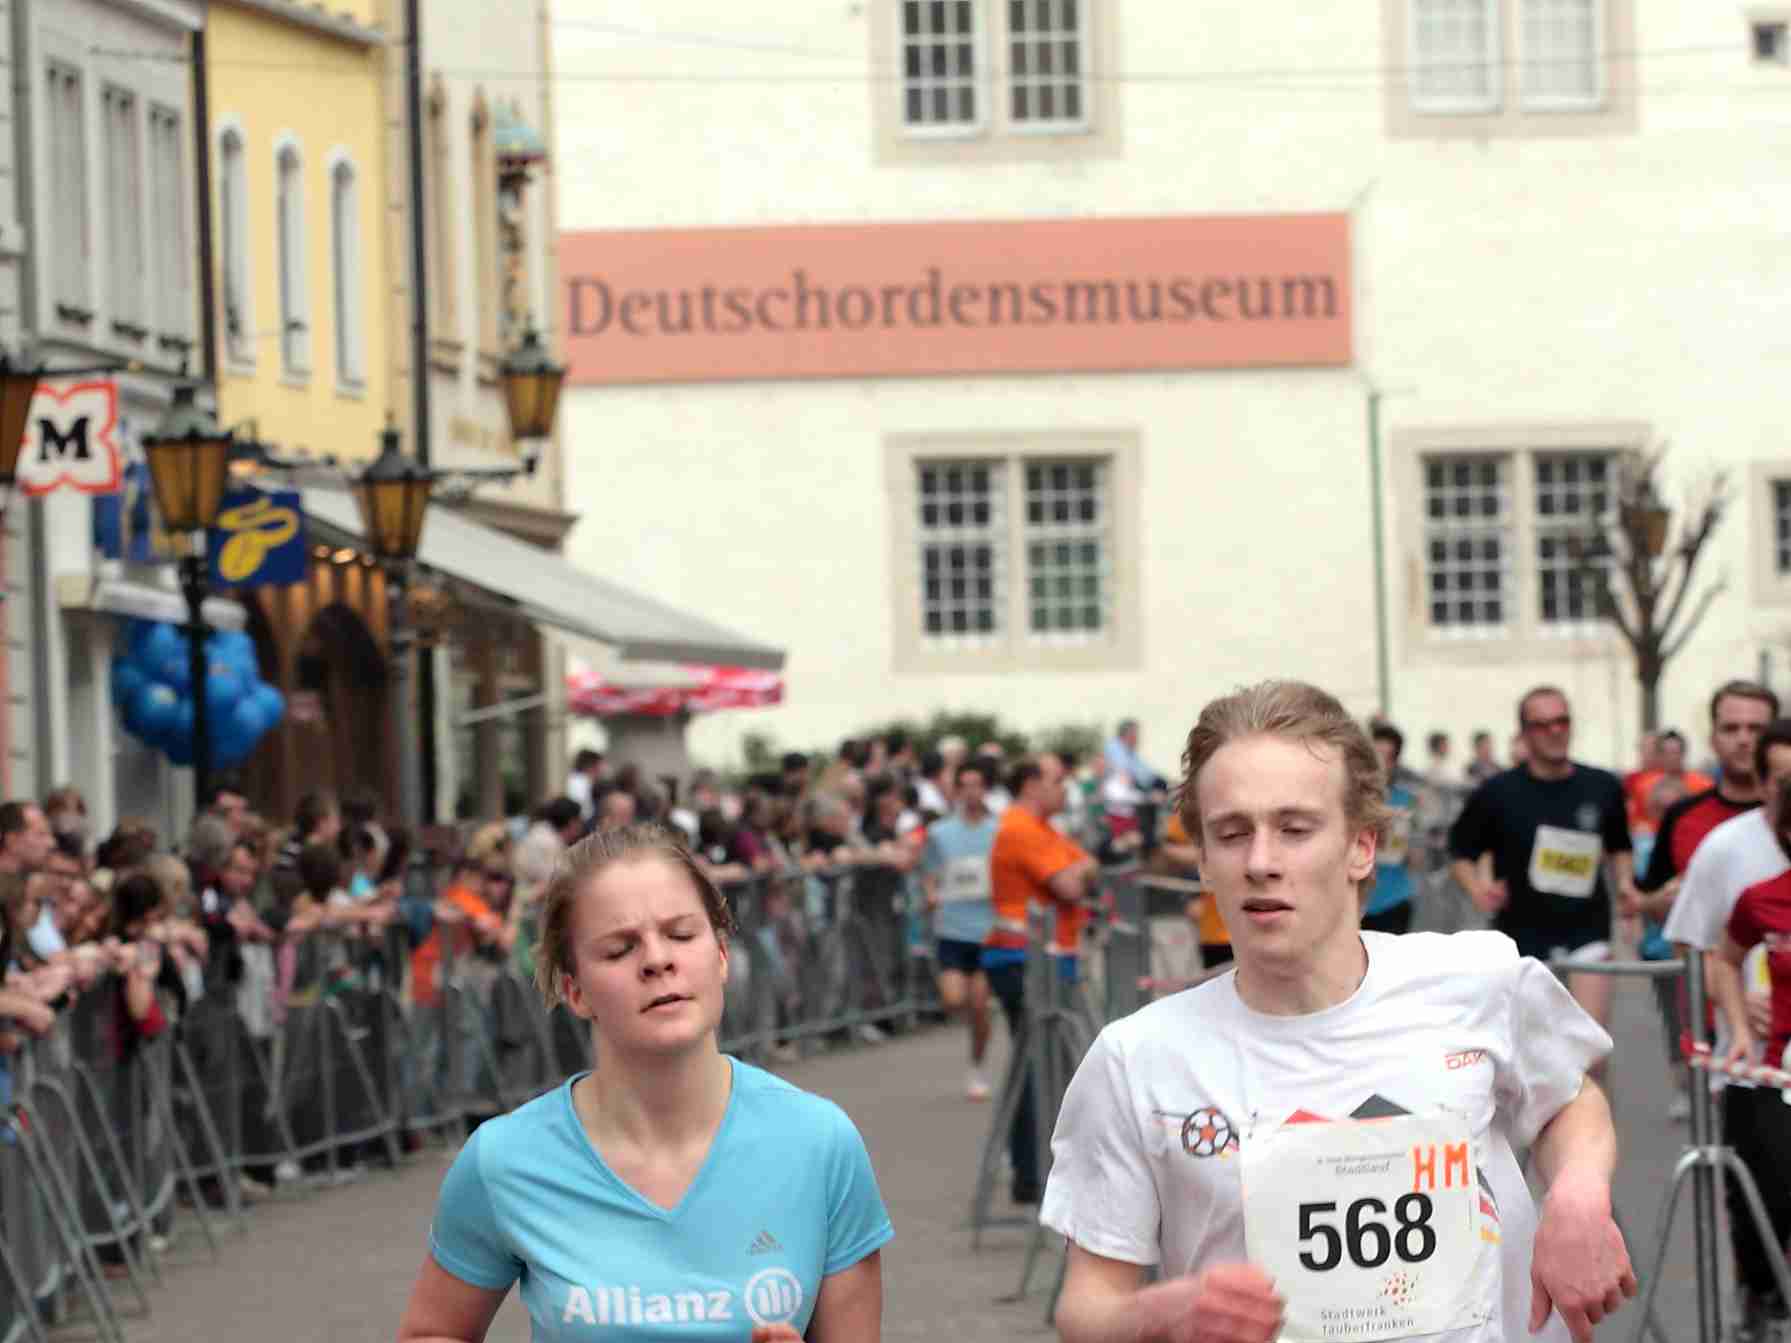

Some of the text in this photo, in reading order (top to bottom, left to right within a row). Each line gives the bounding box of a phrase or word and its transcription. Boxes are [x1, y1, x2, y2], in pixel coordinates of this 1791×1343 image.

[566, 269, 1338, 338] Deutschordensmuseum
[40, 416, 89, 460] M
[1412, 1142, 1469, 1192] HM
[1299, 1193, 1437, 1271] 568
[563, 1284, 733, 1325] Allianz
